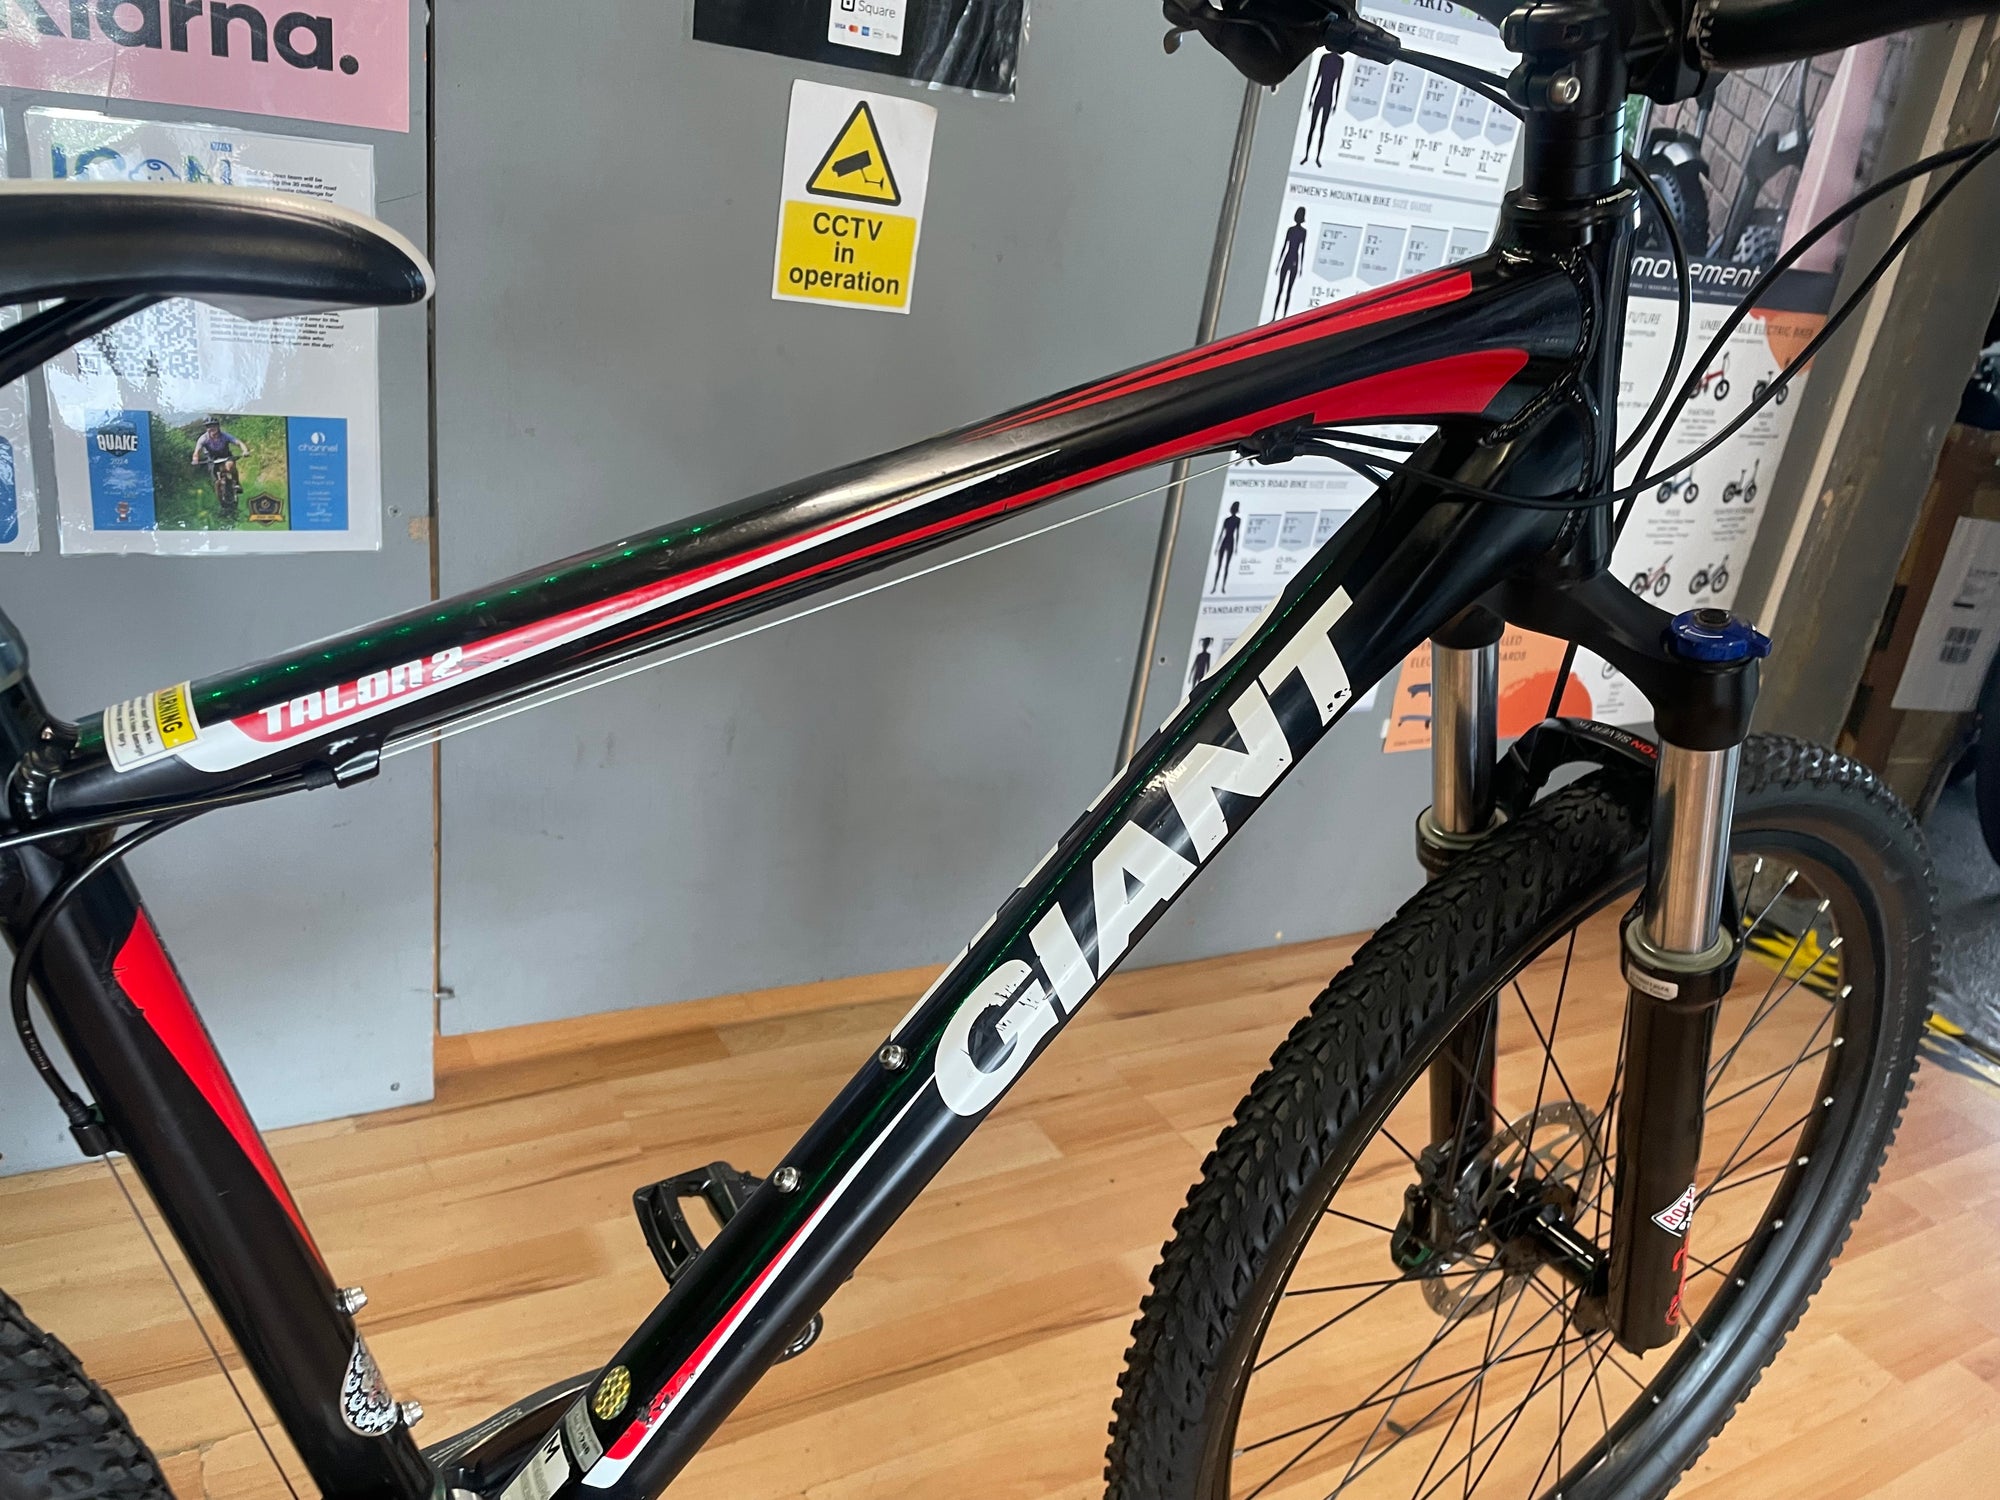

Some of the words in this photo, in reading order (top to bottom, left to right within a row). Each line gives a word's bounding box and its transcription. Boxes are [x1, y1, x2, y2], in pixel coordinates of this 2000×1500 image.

[858, 0, 896, 18] Square
[1398, 21, 1417, 36] BIKE
[1343, 125, 1373, 140] 13-14"
[1379, 131, 1408, 146] 15-16"
[1339, 139, 1352, 150] XS
[1375, 144, 1383, 155] S
[1411, 151, 1420, 161] M
[1444, 156, 1450, 167] L
[1477, 162, 1488, 173] XL
[1289, 183, 1328, 198] WOMEN'S
[1329, 190, 1371, 204] MOUNTAIN
[1372, 195, 1391, 208] BIKE
[813, 212, 883, 241] CCTV
[834, 241, 854, 264] in
[789, 267, 899, 295] operation
[97, 434, 138, 452] QUAKE
[1229, 479, 1266, 488] WOMEN'S
[1290, 480, 1308, 489] BIKE
[1202, 606, 1244, 615] STANDARD
[258, 659, 423, 735] TALON
[432, 646, 463, 681] 2
[935, 585, 1353, 1116] GIANT
[542, 1432, 561, 1465] M
